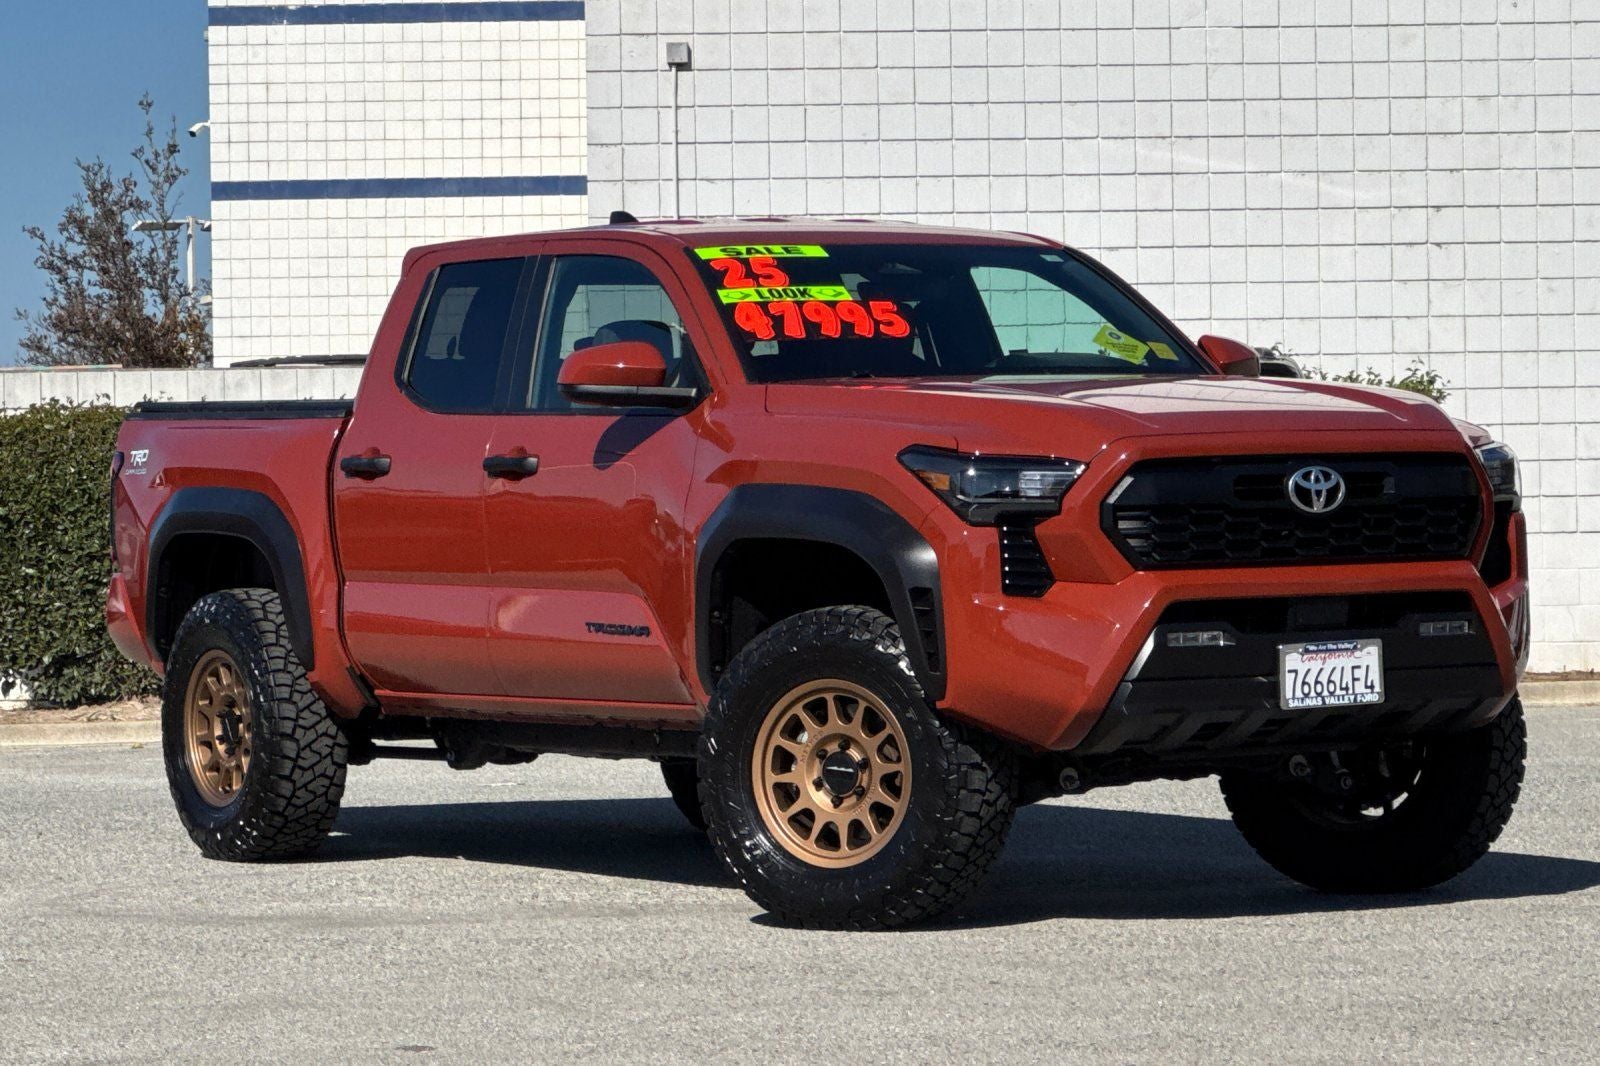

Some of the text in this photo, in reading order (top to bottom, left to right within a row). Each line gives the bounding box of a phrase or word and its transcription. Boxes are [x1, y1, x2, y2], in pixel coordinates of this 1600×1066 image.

[719, 246, 807, 256] SALE
[709, 255, 790, 288] 25
[754, 287, 814, 300] LOOK
[734, 300, 910, 339] 47995
[130, 449, 149, 467] TRD
[1301, 651, 1356, 665] California
[1287, 664, 1376, 698] 76664F4
[1325, 695, 1355, 705] VALLEY
[1357, 693, 1379, 702] FORD
